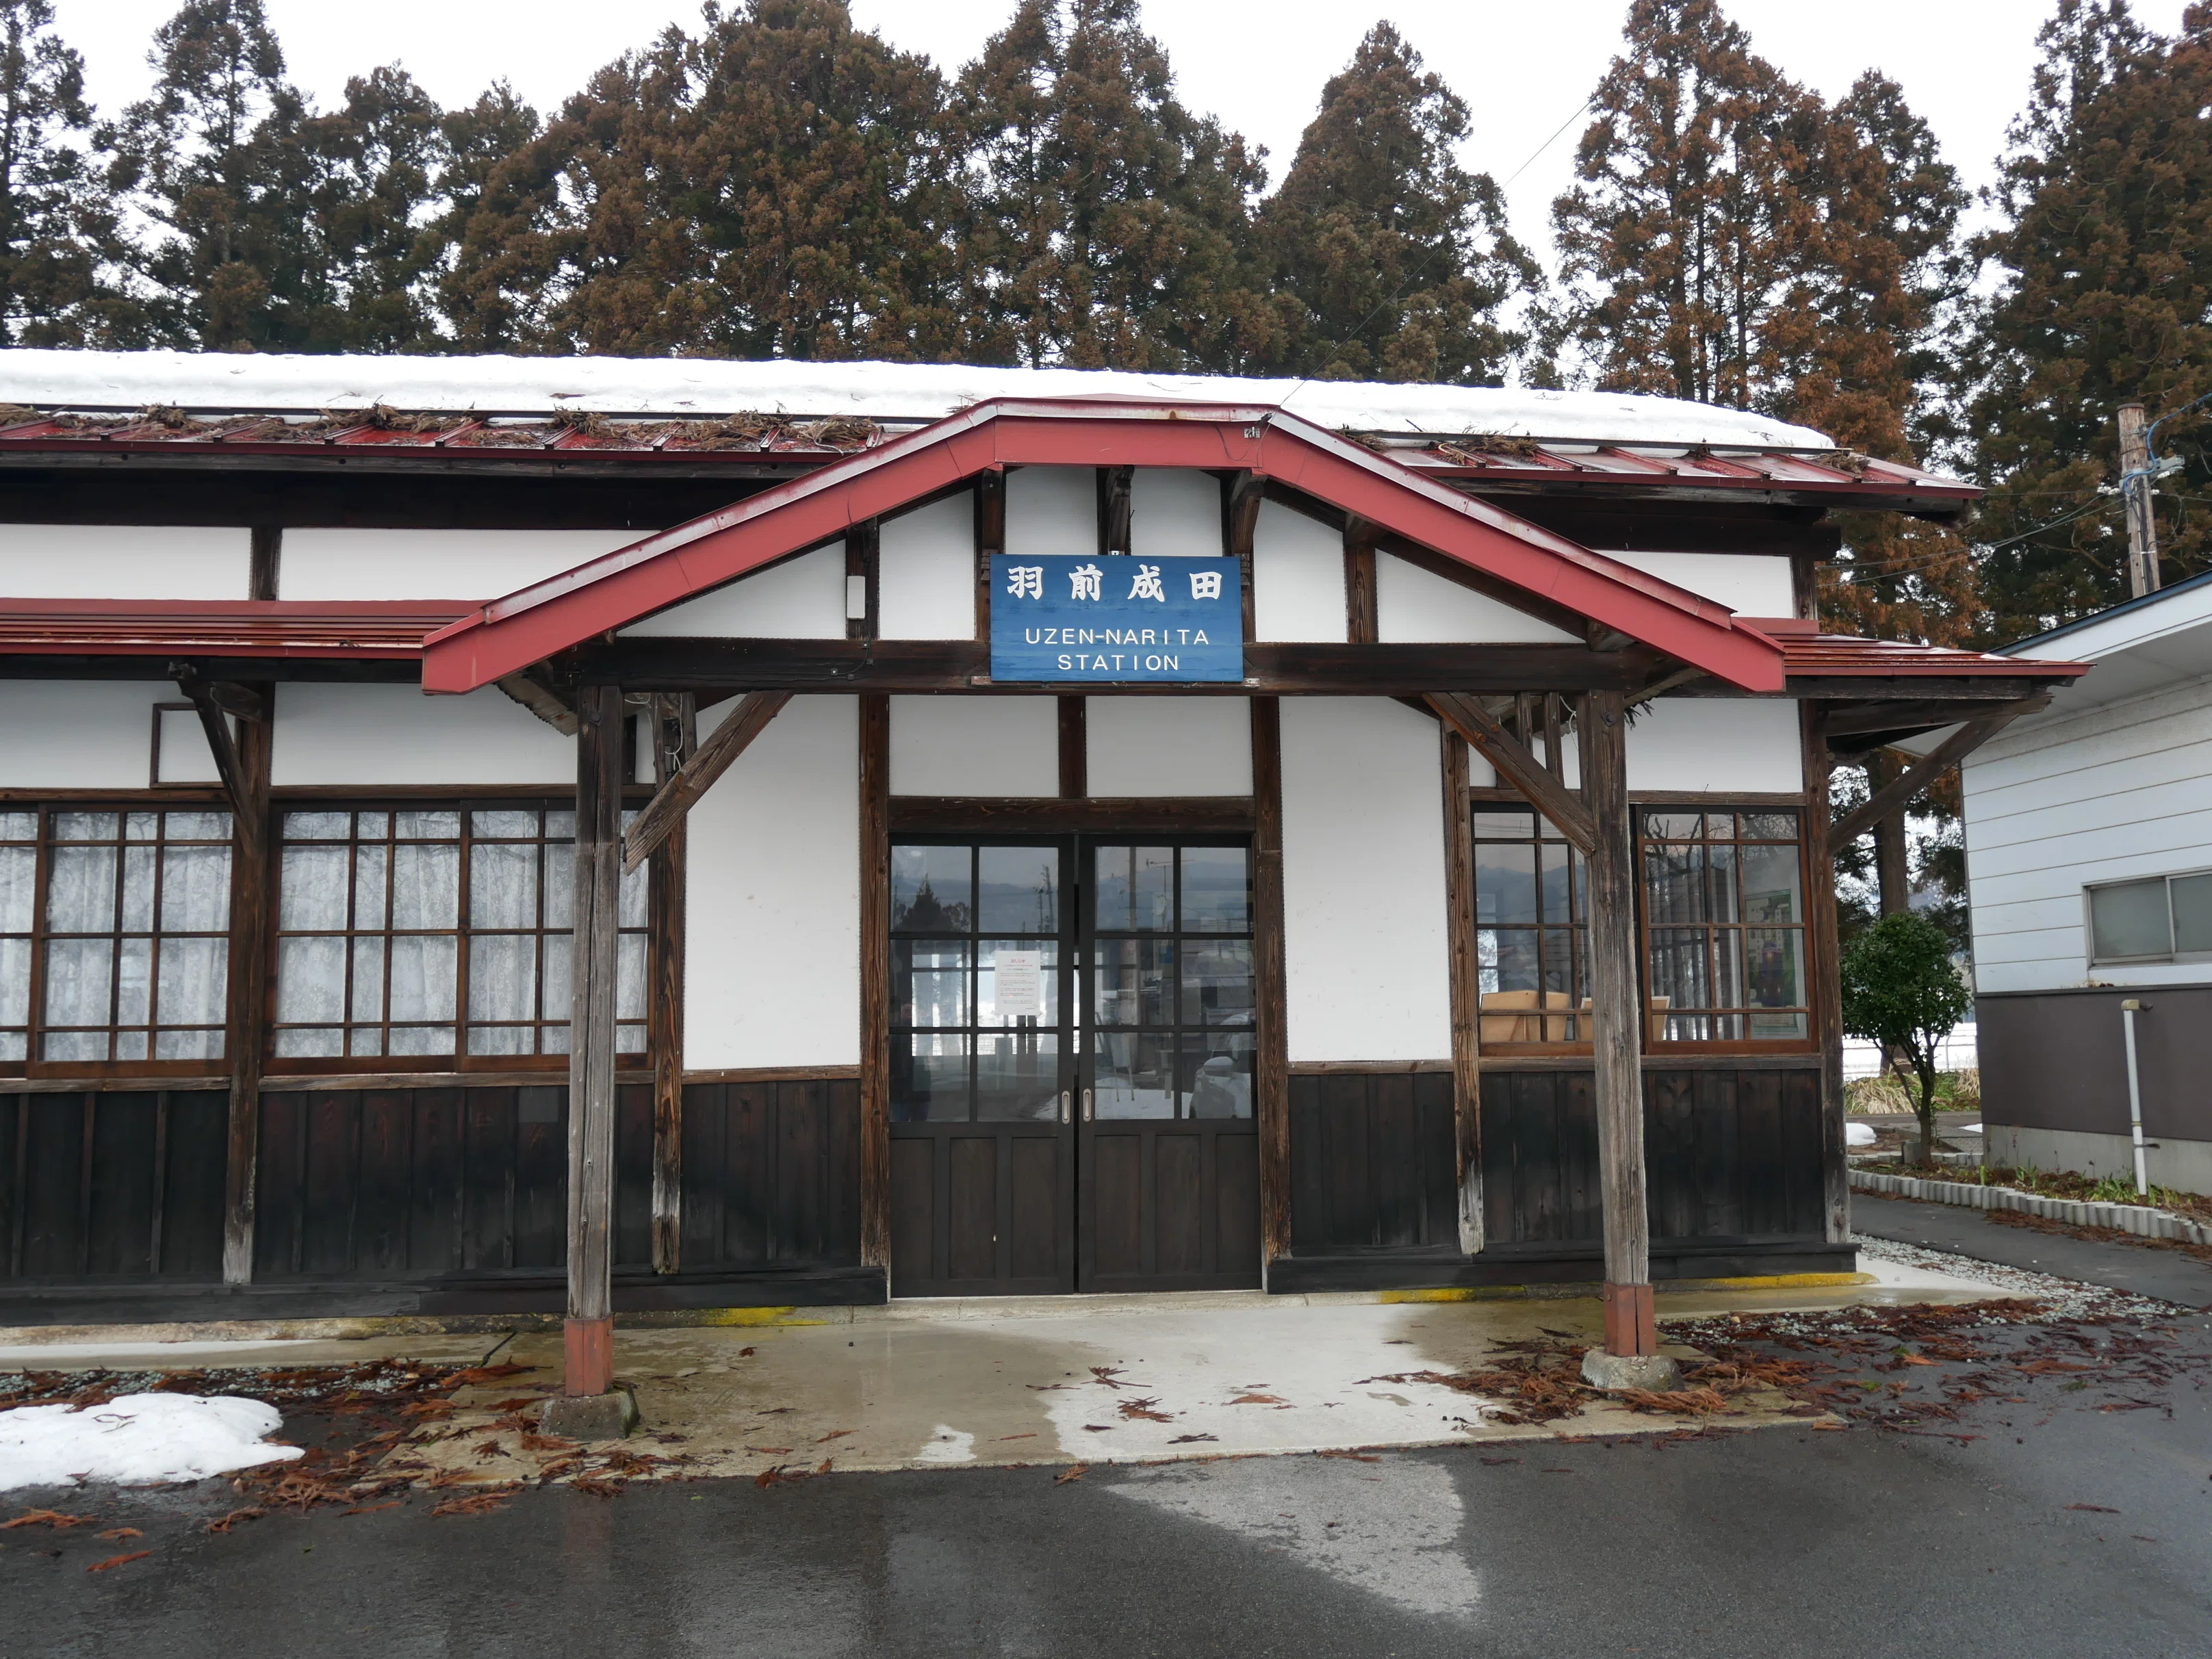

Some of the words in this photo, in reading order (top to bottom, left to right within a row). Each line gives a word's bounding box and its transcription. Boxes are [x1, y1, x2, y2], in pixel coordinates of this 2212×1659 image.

[1007, 563, 1222, 602] 羽前成田
[1025, 628, 1209, 645] UZEN-NARITA
[1057, 654, 1178, 671] STATION
